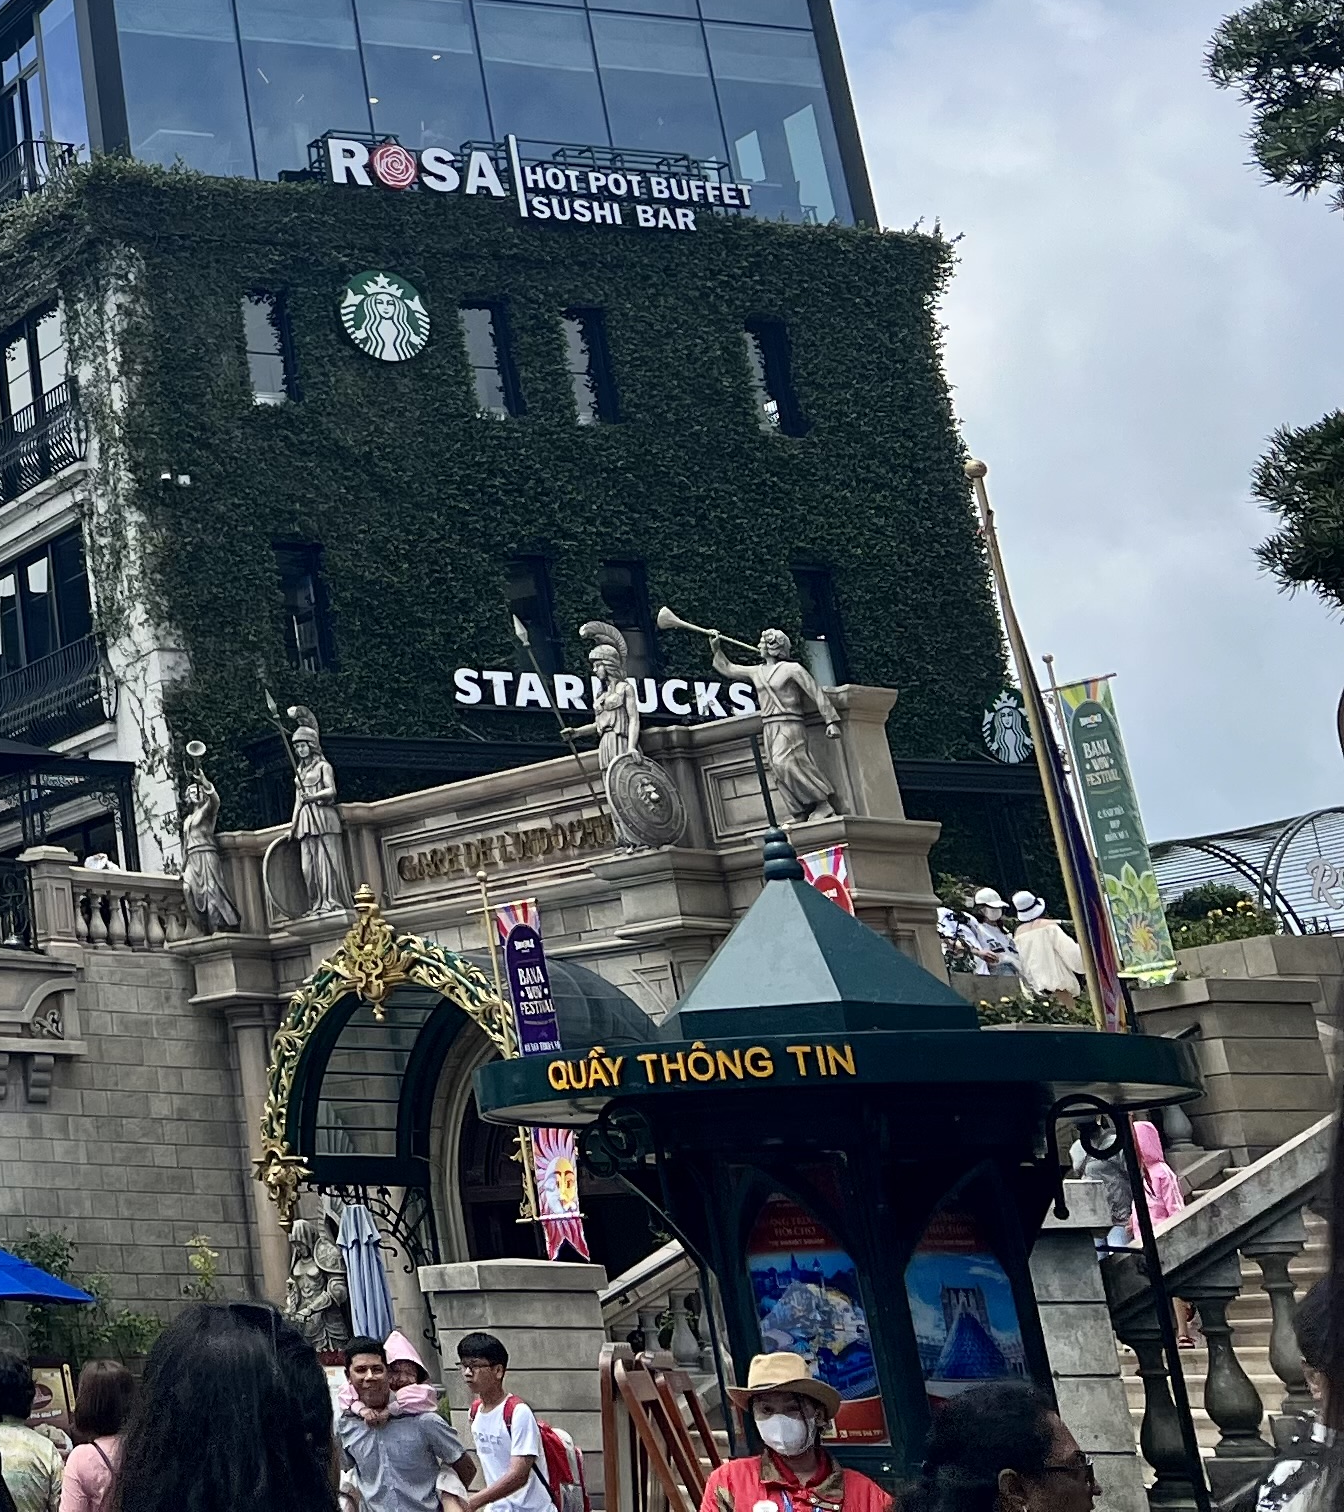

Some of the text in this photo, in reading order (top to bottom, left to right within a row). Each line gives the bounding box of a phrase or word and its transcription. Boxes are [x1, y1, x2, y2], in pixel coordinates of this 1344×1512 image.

[524, 166, 752, 206] HOT POT BUFFET
[531, 196, 697, 231] SUSHI BAR
[453, 667, 761, 717] STARUCKS
[637, 1040, 774, 1084] THÔNG
[786, 1044, 857, 1076] TIN
